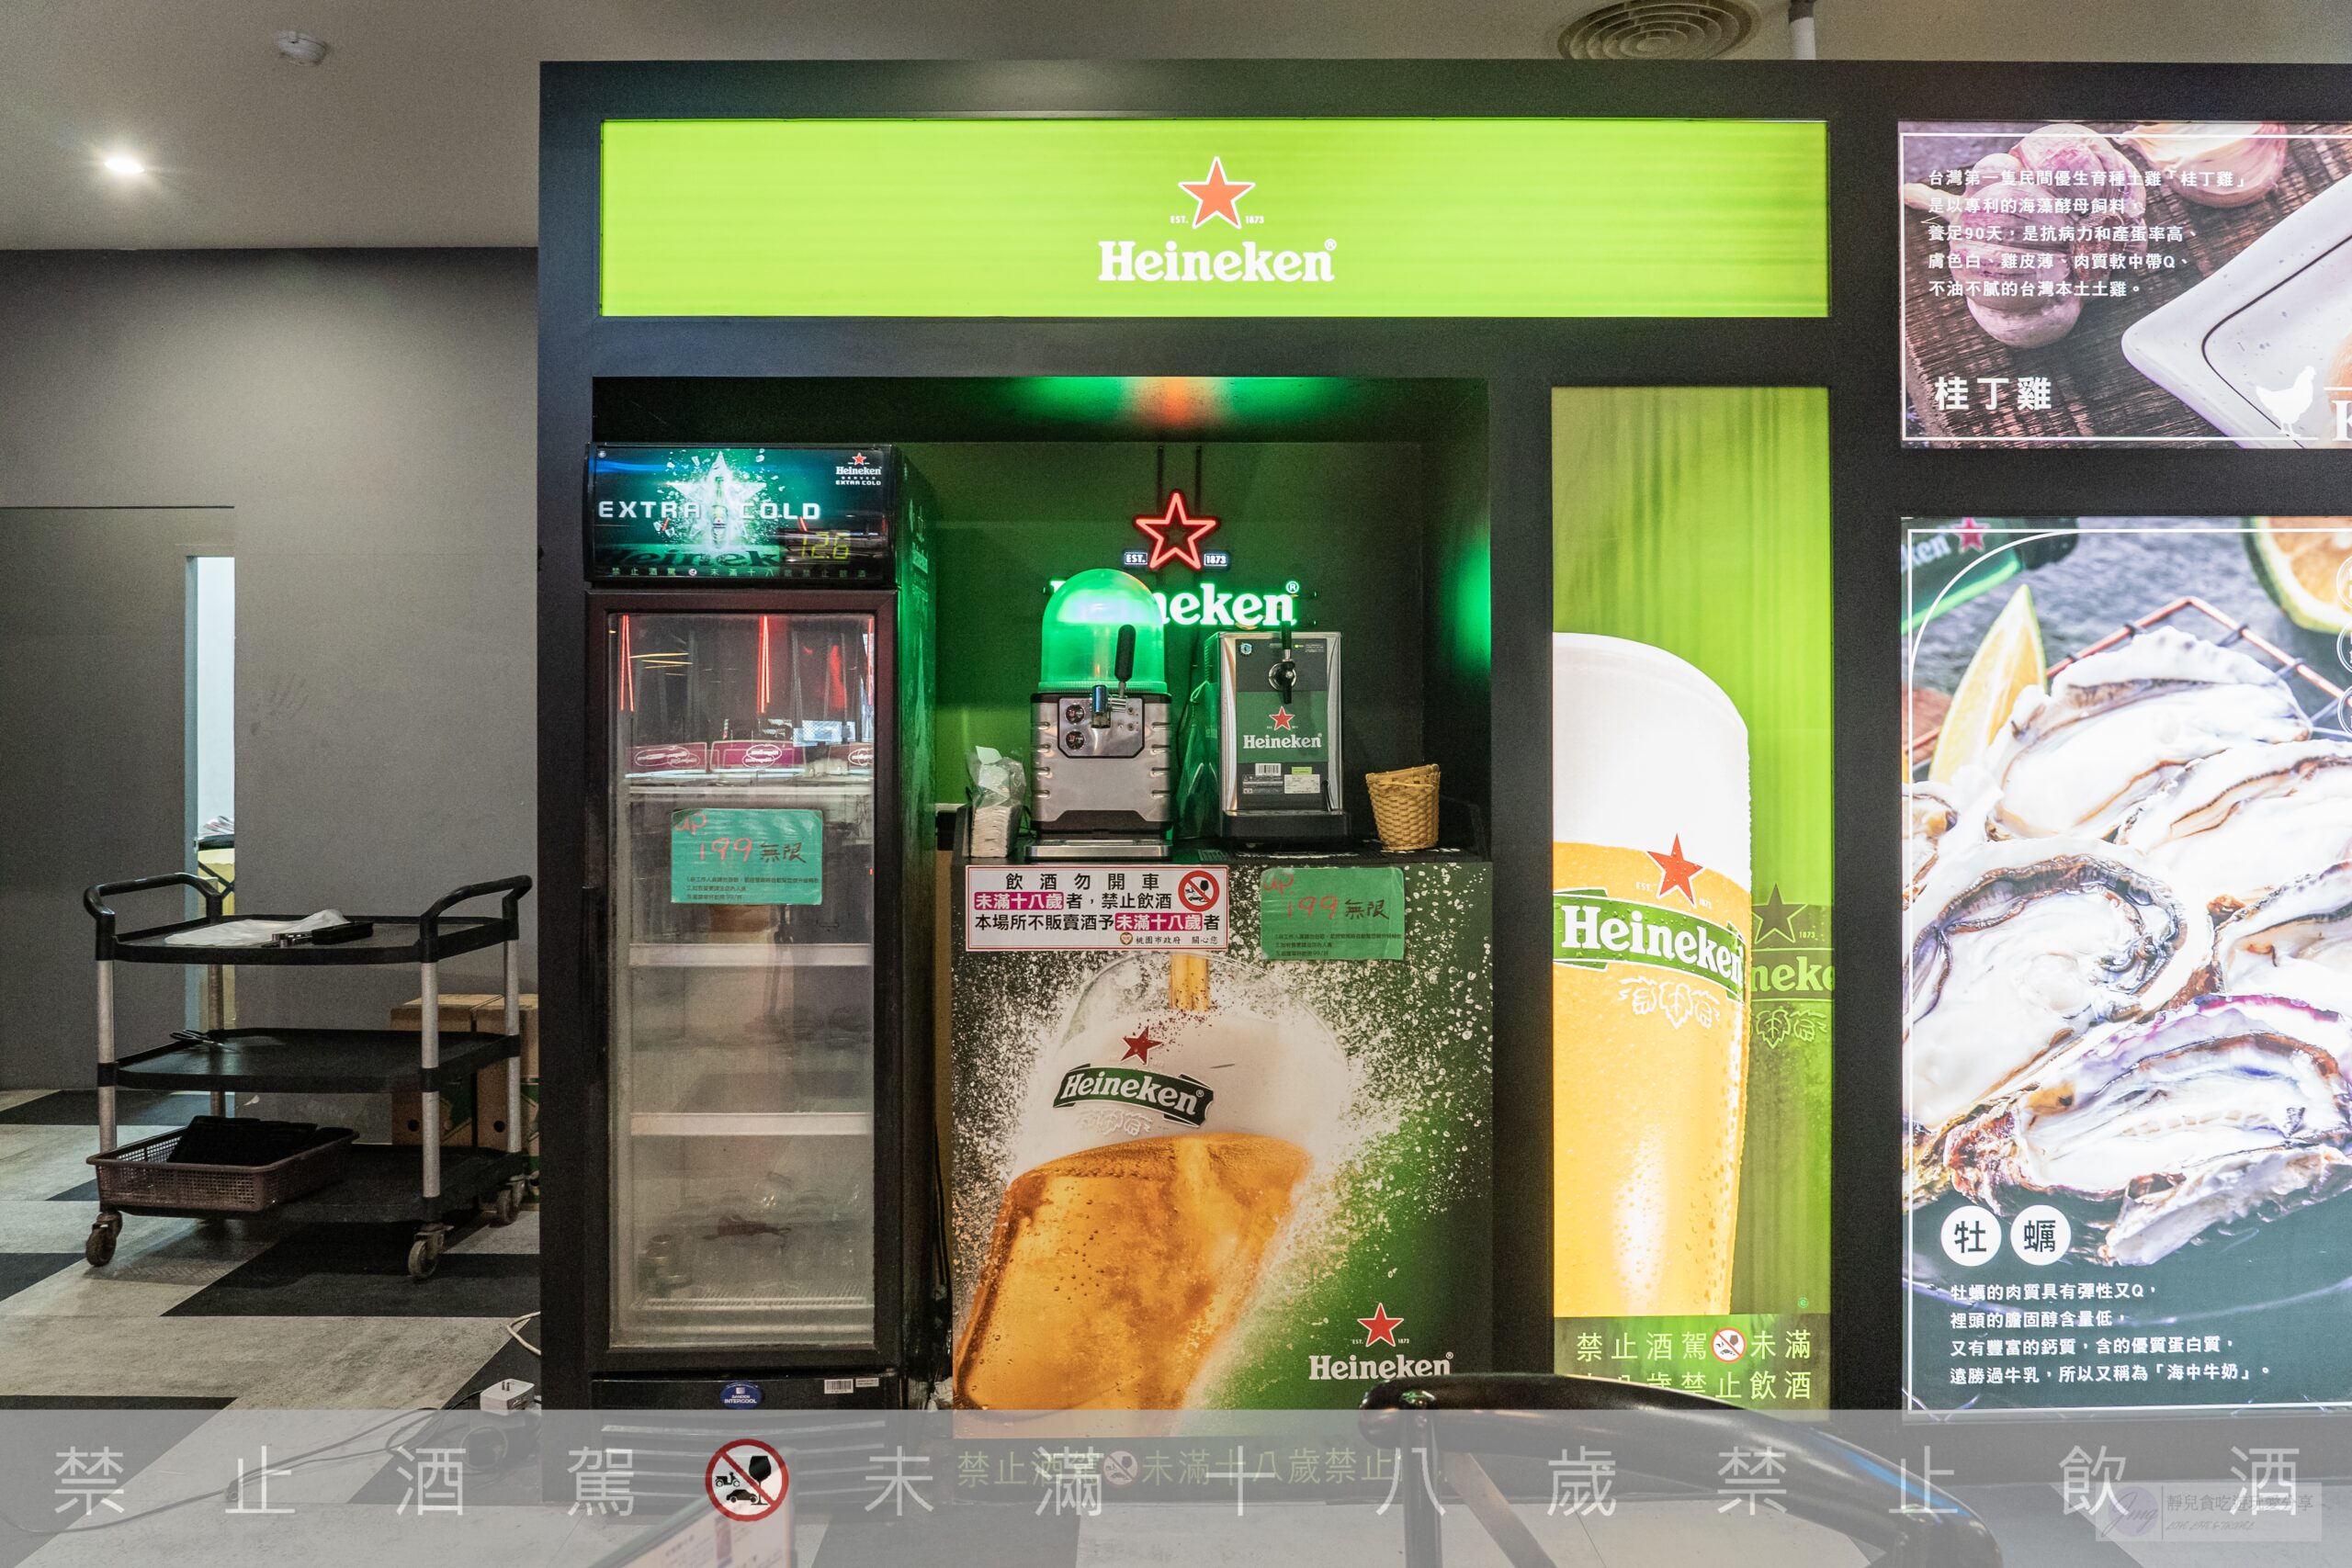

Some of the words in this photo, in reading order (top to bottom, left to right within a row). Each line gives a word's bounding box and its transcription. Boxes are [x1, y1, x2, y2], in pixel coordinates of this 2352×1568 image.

[1170, 215, 1188, 224] EST.
[1246, 215, 1264, 224] 1873
[1935, 377, 2052, 411] 桂丁雞
[598, 501, 701, 518] EXTRA
[742, 502, 821, 520] COLD
[1126, 554, 1146, 564] EST.
[1205, 555, 1227, 565] 1873
[1954, 1220, 2056, 1254] 牡蠣
[1577, 1331, 1707, 1362] 禁止酒駕
[1750, 1329, 1811, 1360] 未滿
